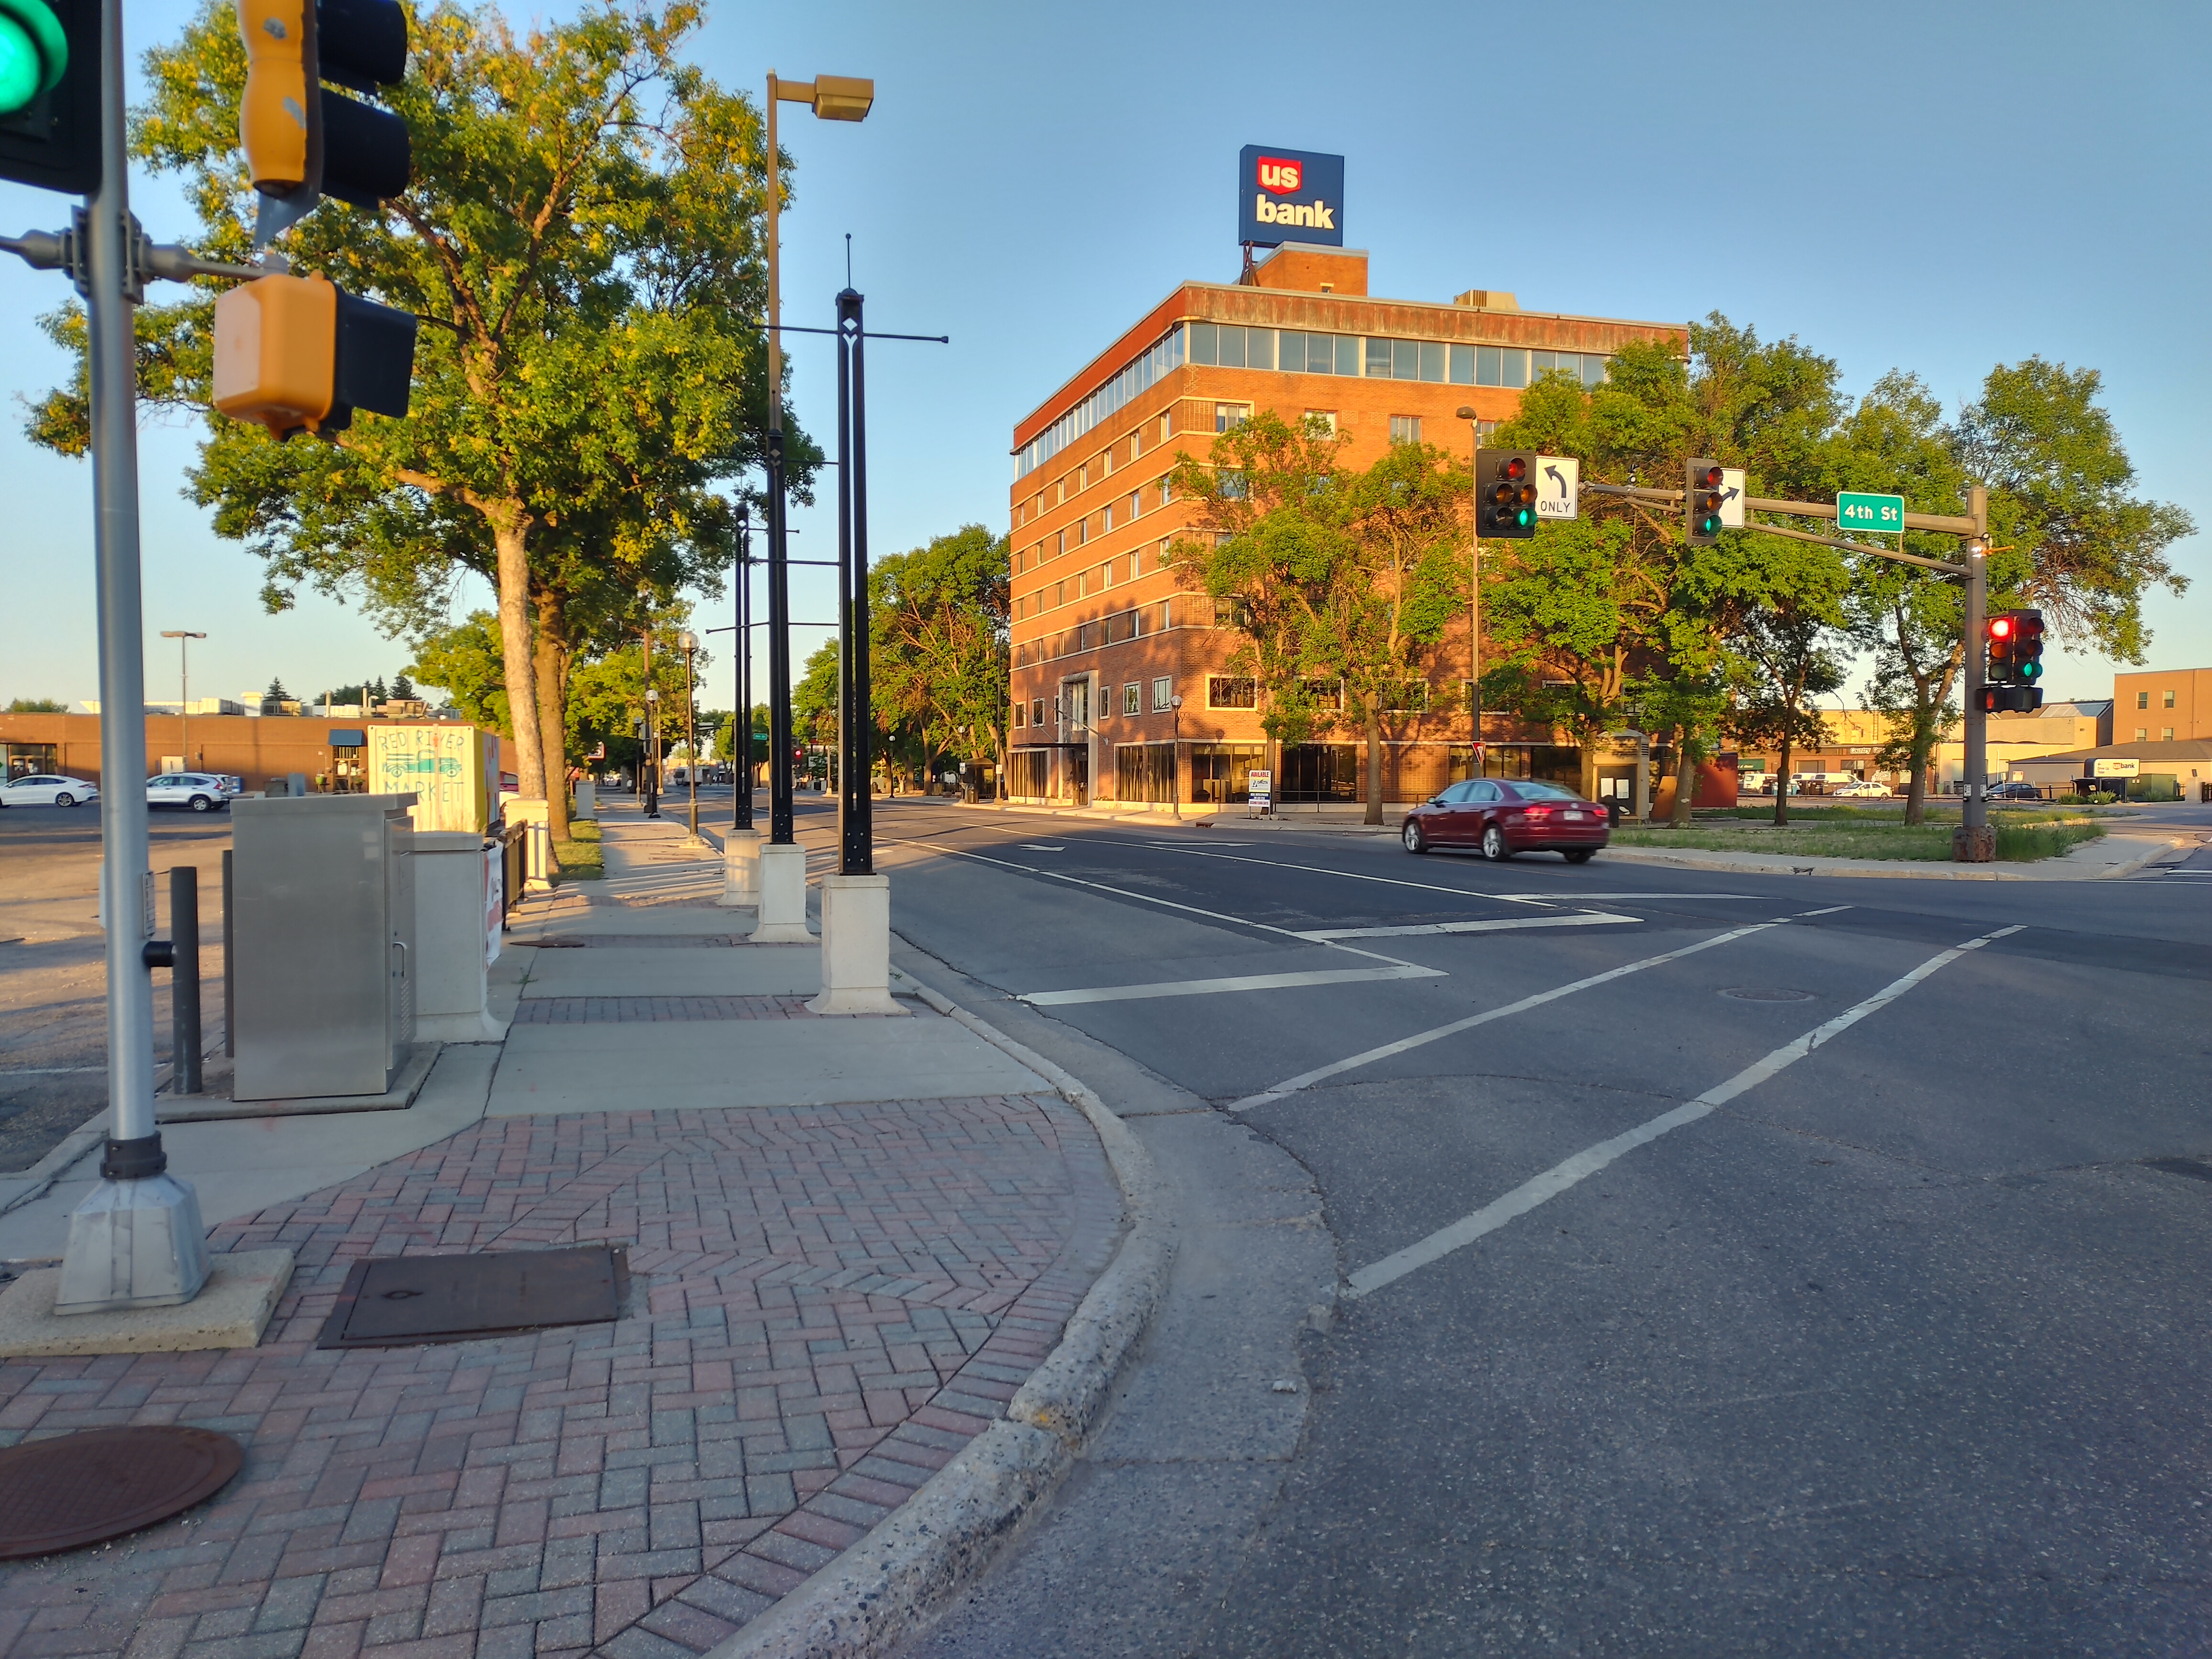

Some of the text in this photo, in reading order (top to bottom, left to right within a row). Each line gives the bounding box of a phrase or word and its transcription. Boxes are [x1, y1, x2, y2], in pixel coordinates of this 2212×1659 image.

[1261, 164, 1298, 188] us
[1257, 193, 1335, 229] bank
[1541, 501, 1571, 513] ONLY
[1845, 504, 1898, 521] 4th St
[378, 732, 407, 751] RED
